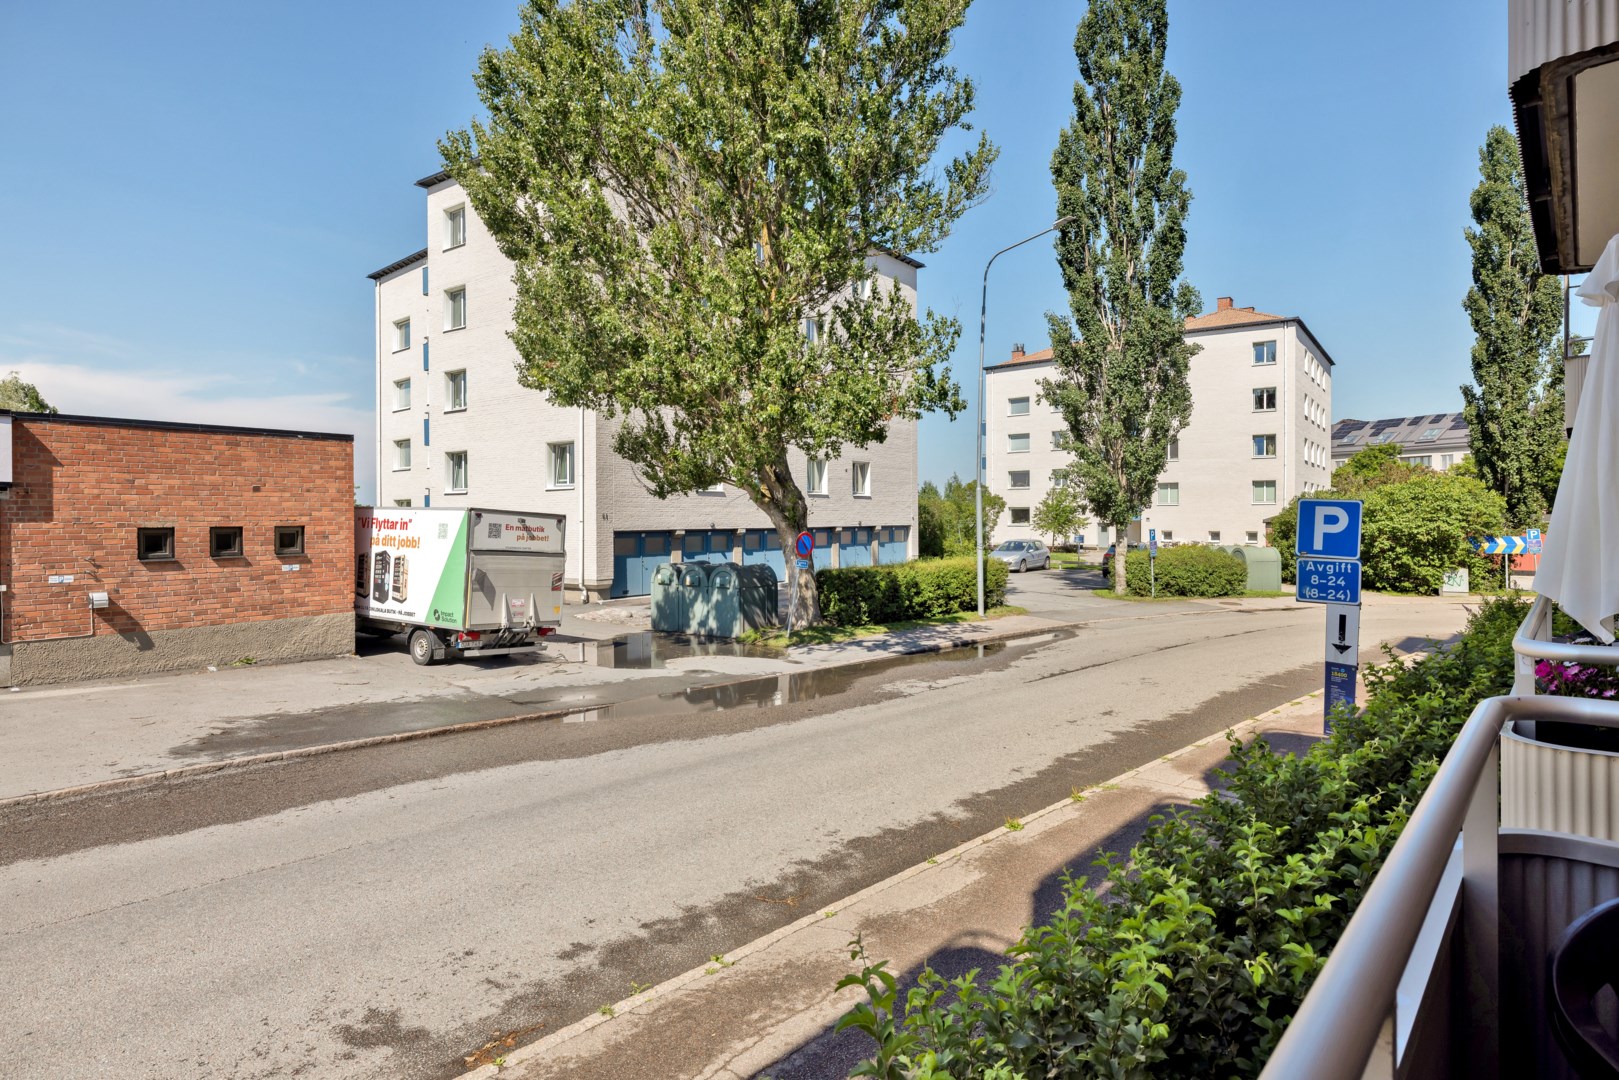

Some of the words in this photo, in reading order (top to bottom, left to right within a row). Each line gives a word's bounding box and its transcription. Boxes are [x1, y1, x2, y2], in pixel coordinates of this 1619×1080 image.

[371, 517, 398, 532] Flyttar
[505, 523, 514, 531] En
[515, 524, 545, 533] matbutik
[1313, 506, 1349, 550] P
[517, 533, 525, 542] på
[526, 534, 549, 543] jobbet!
[1530, 530, 1538, 539] P
[370, 533, 379, 548] på
[381, 534, 396, 548] ditt
[397, 535, 420, 550] jobb!
[1306, 562, 1352, 574] Avgift
[1311, 575, 1346, 587] 8-24
[1306, 587, 1351, 601] (8-24)
[440, 610, 454, 618] Impact
[441, 615, 457, 624] Solution
